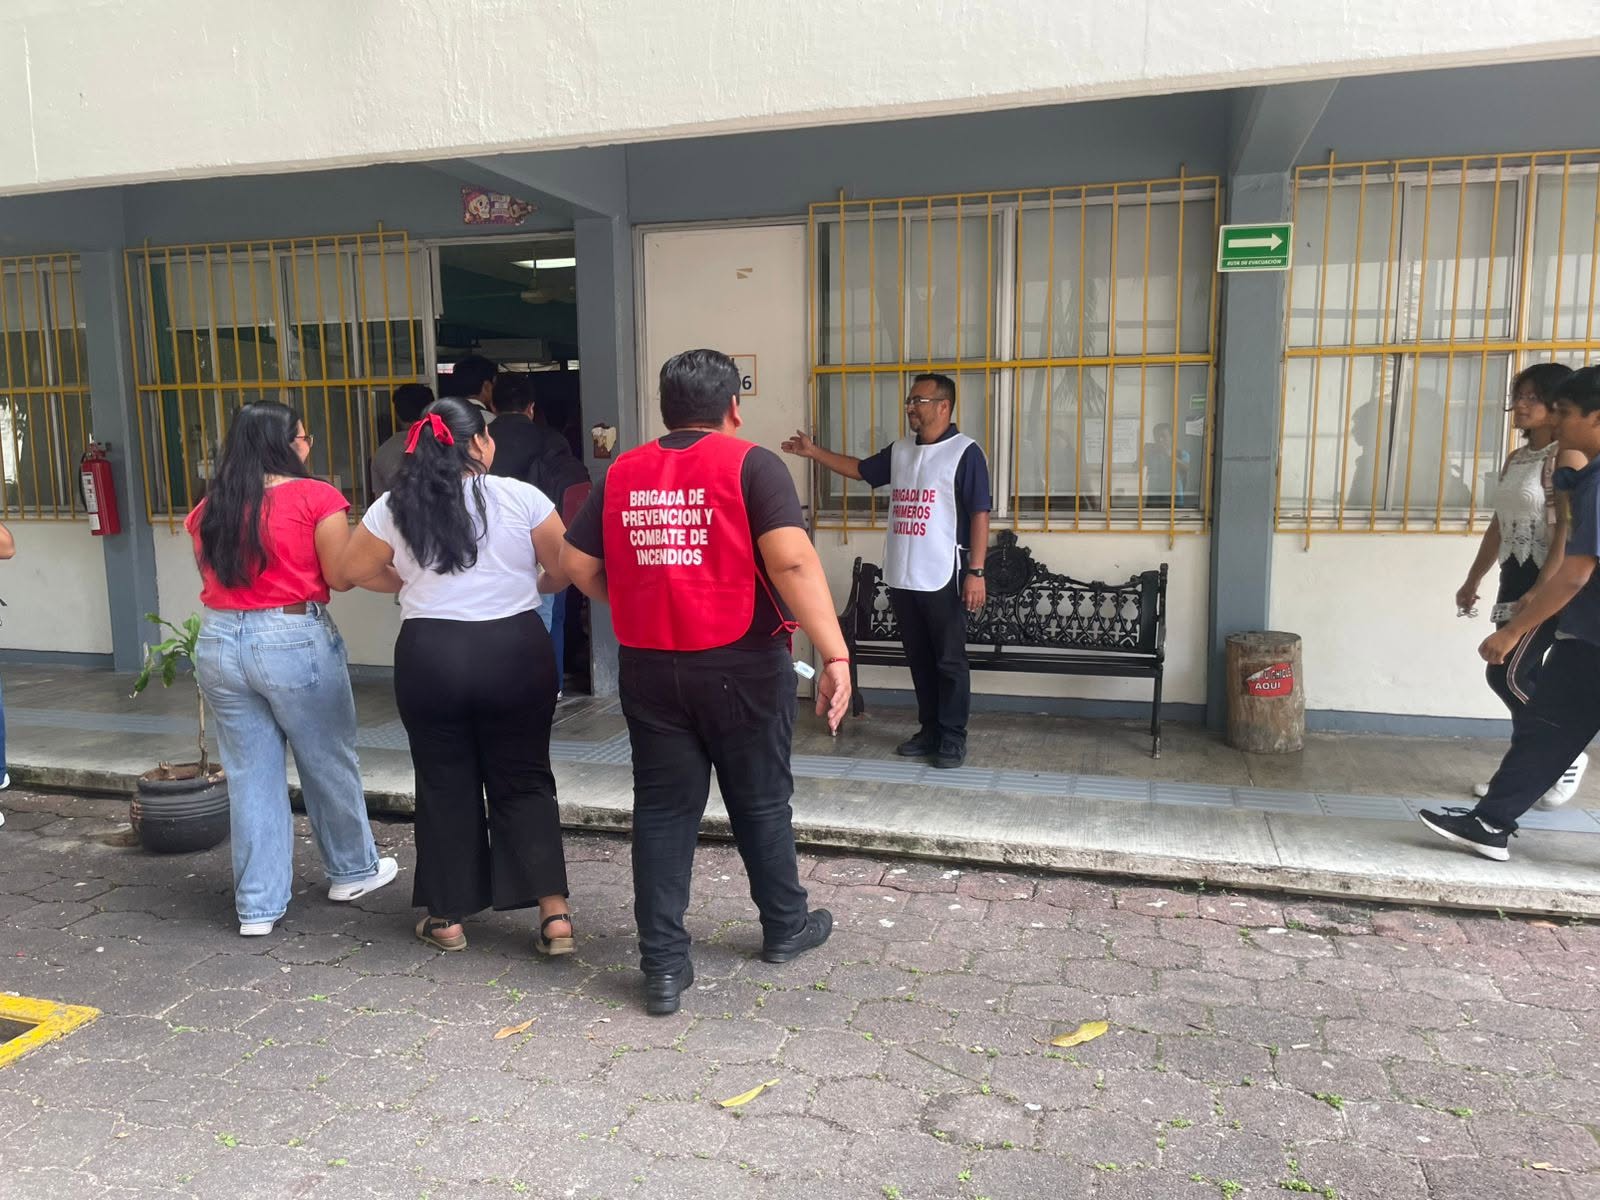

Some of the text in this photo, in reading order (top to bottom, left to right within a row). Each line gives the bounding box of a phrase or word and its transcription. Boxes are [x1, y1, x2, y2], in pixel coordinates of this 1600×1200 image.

[630, 488, 705, 507] BRIGADA DE
[922, 489, 936, 503] DE
[621, 508, 713, 527] PREVENCION Y
[630, 528, 708, 546] COMBATE DE
[893, 521, 926, 536] UXILIOS
[636, 549, 703, 566] INCENDIOS
[1255, 682, 1281, 690] AQUI
